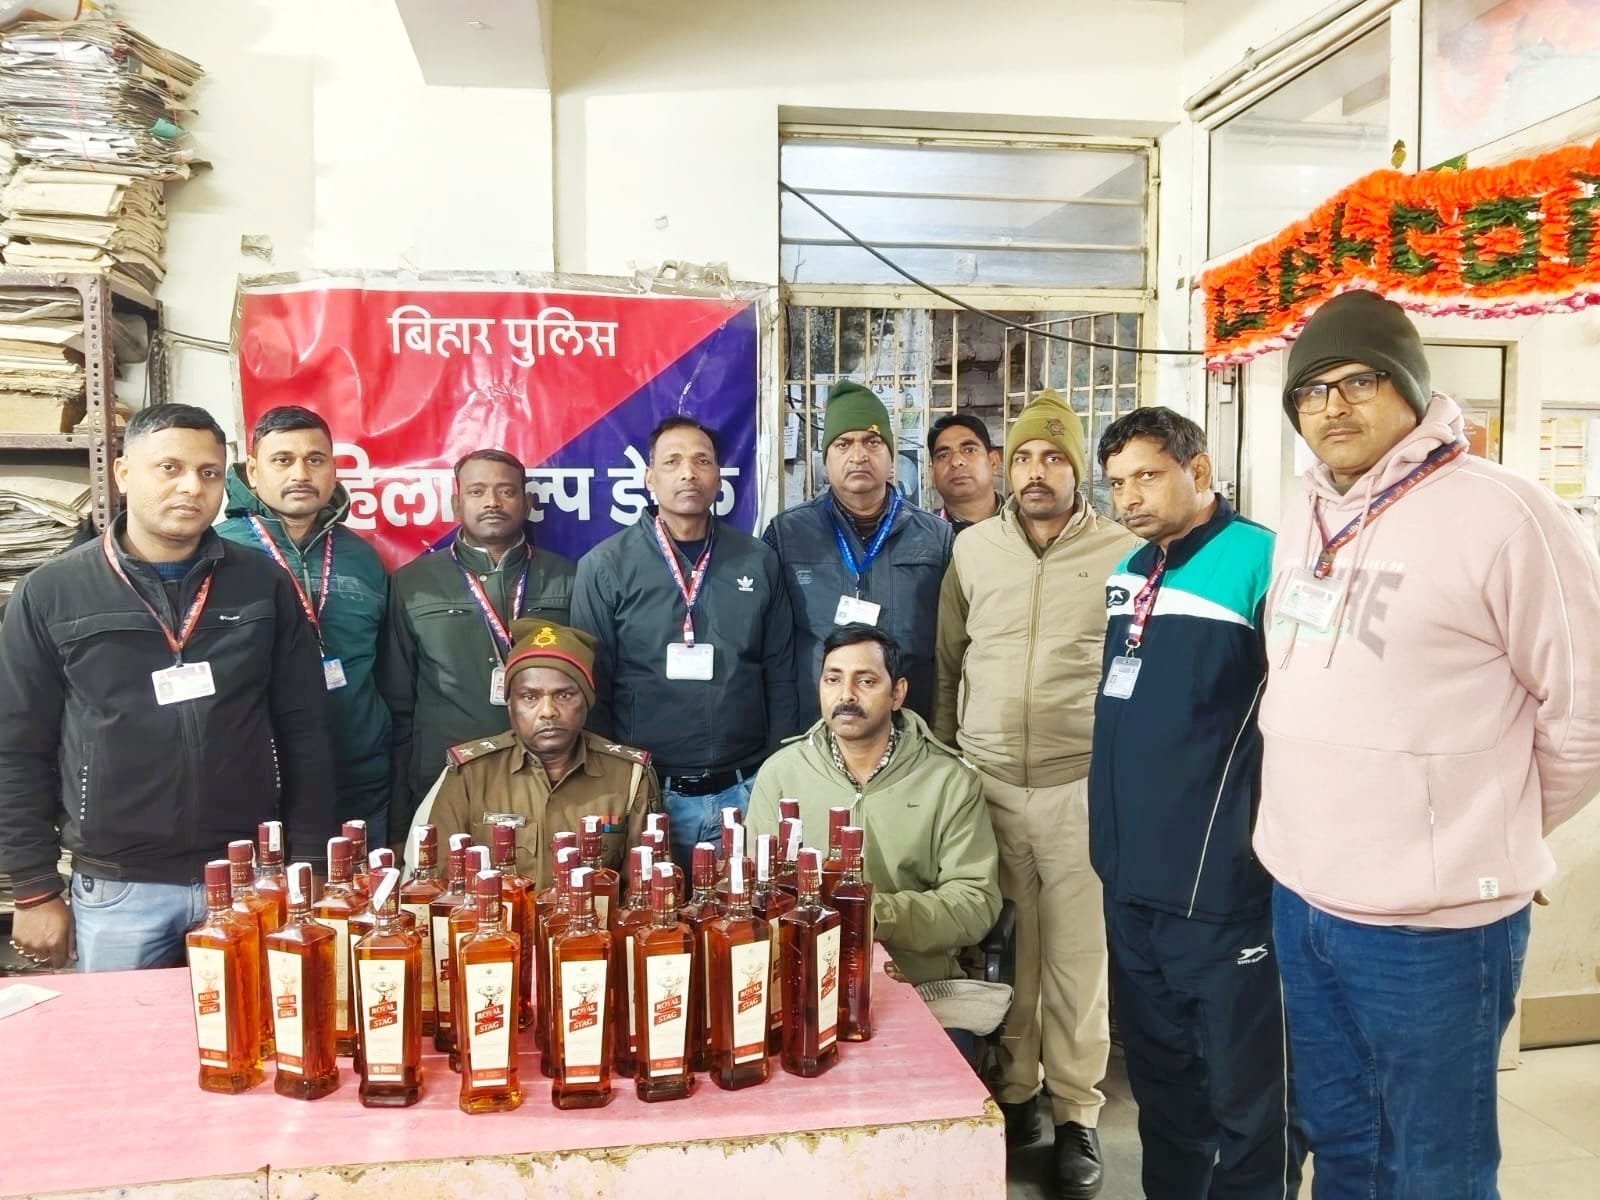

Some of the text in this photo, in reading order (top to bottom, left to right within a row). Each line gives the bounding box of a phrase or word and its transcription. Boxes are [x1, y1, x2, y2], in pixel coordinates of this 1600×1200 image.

[387, 305, 618, 368] बिहार पुलिस
[333, 443, 457, 530] हिला
[371, 1003, 396, 1016] ROYAL
[656, 998, 680, 1011] ROYAL
[741, 997, 760, 1010] STAG
[476, 1006, 502, 1020] ROYAL
[571, 1004, 596, 1018] ROYAL
[657, 1011, 678, 1024] STAG
[373, 1016, 393, 1029] STAG
[479, 1021, 500, 1034] STAG
[573, 1018, 594, 1031] STAG
